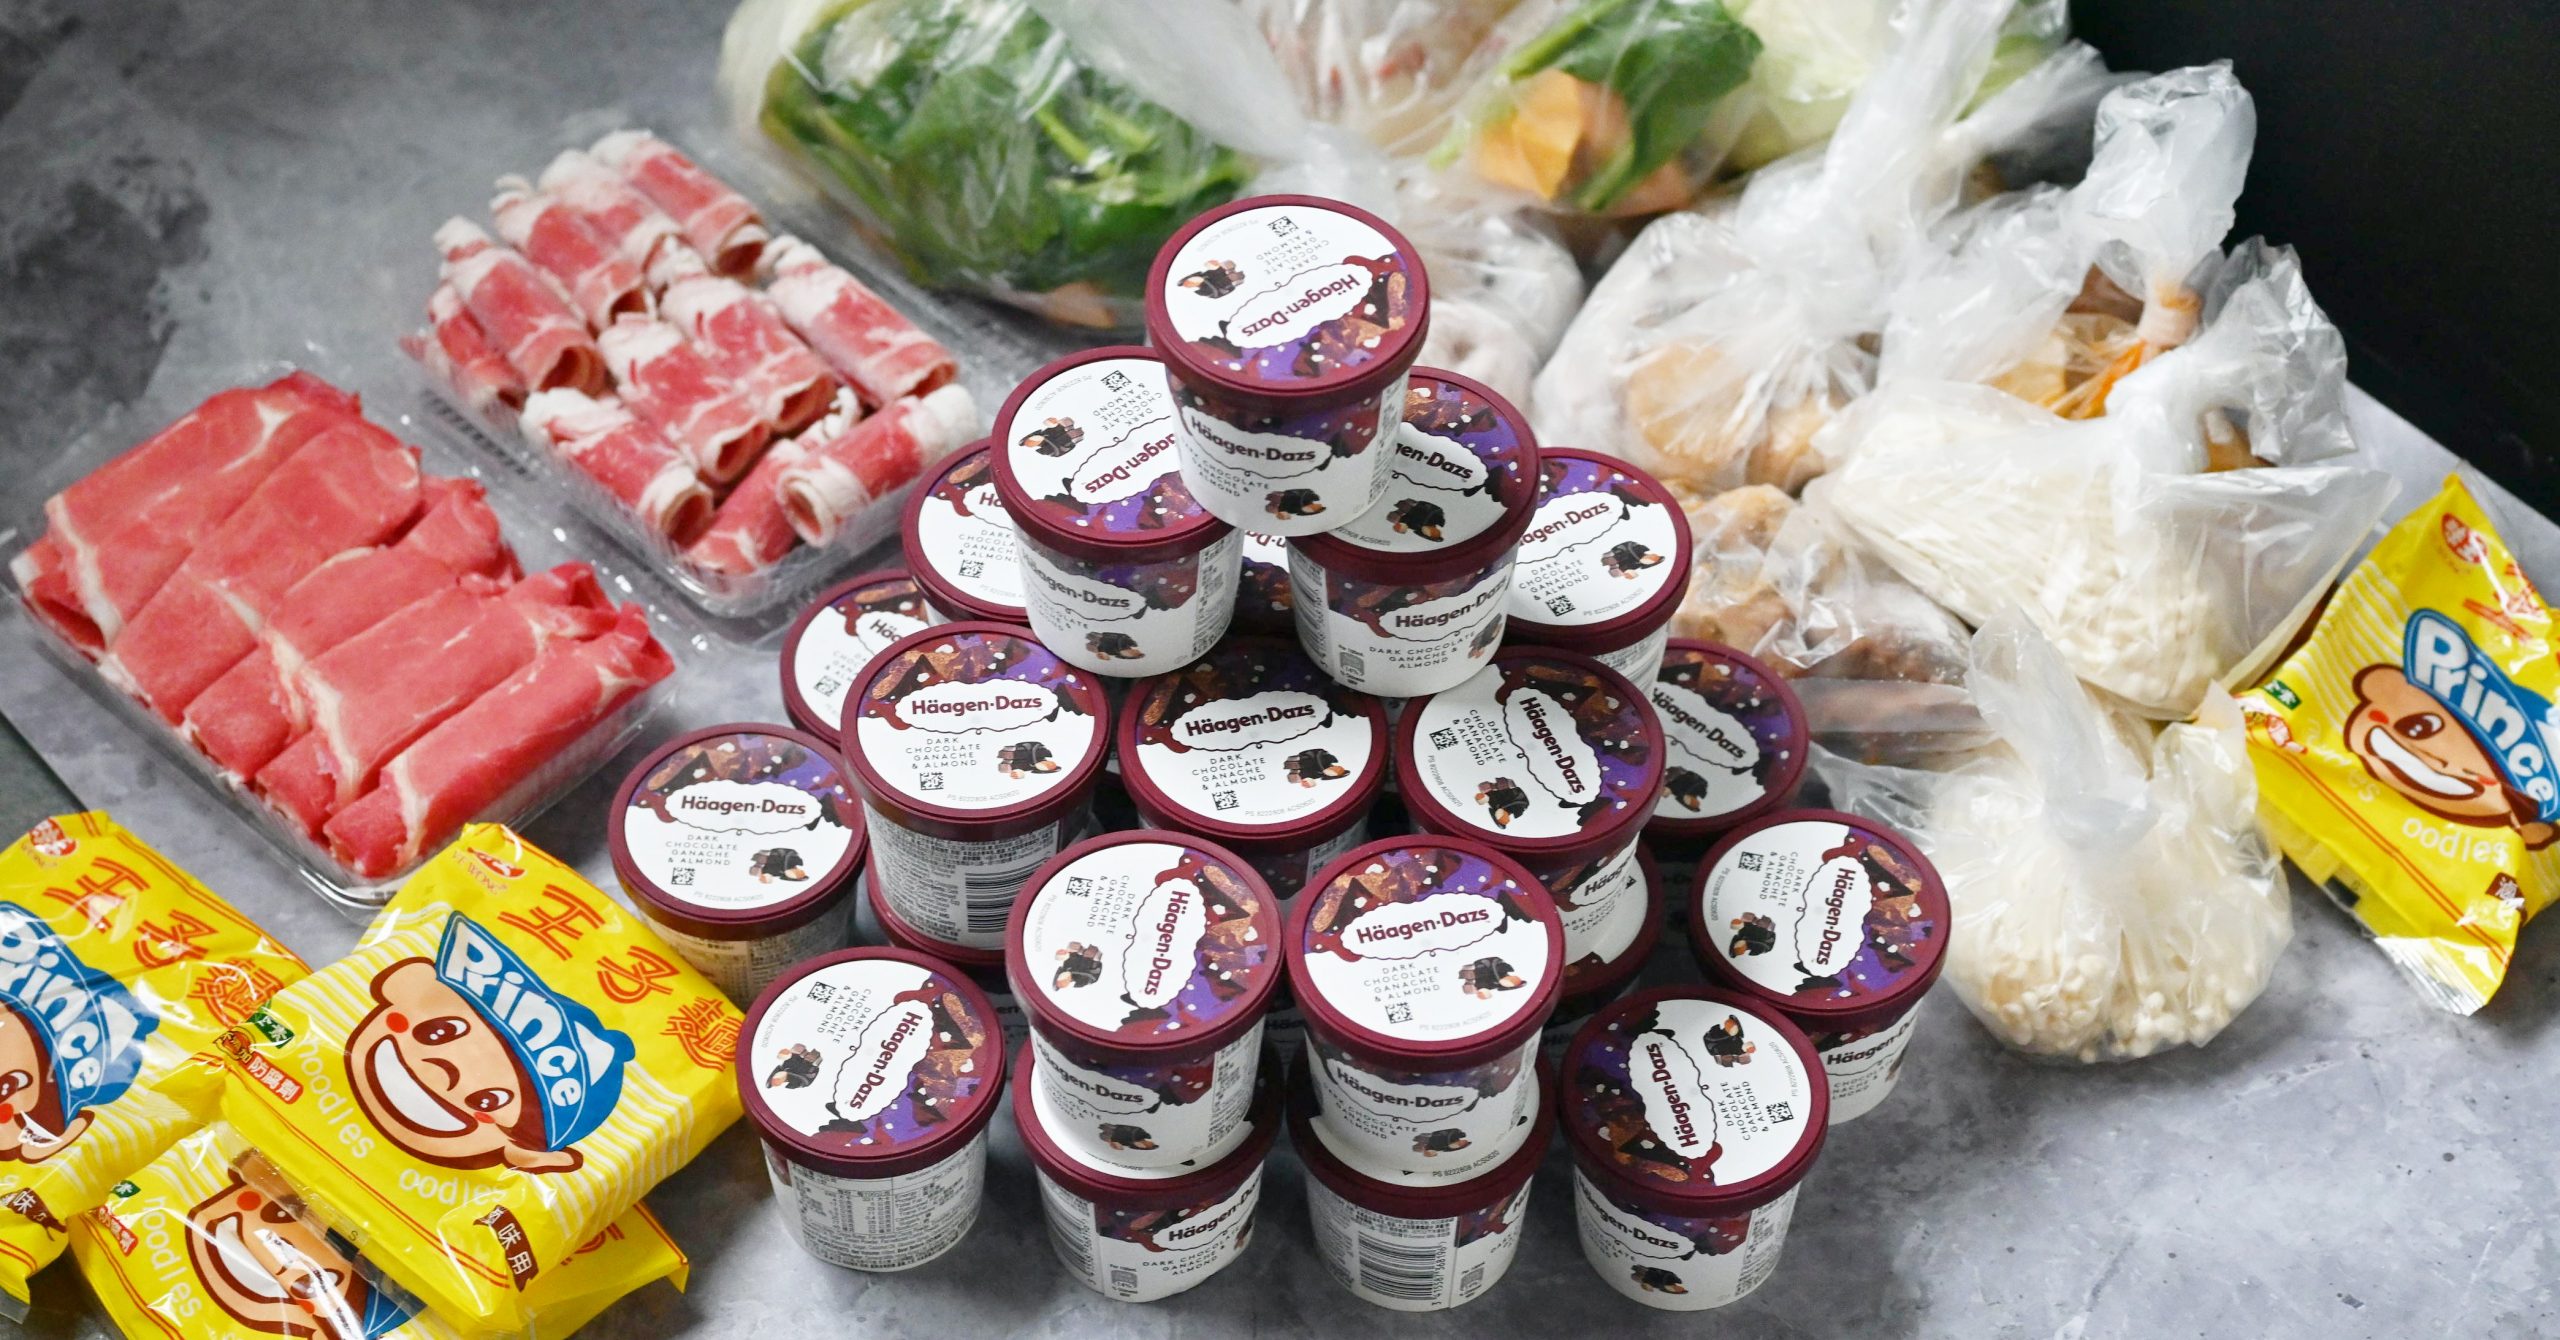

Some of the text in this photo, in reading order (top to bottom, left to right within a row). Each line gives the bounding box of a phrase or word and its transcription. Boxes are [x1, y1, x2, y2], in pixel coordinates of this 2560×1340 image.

[1256, 236, 1301, 260] ALMOND
[1264, 236, 1317, 264] GANACHE
[1264, 239, 1330, 276] CHOCOLATE
[1287, 254, 1318, 272] DARK
[1103, 392, 1162, 431] CHOCOLATE
[1124, 408, 1153, 425] DARK
[958, 534, 1015, 546] CHOCOLA
[1519, 559, 1584, 590] CHOCOLATE
[1530, 568, 1583, 593] GANACHE
[1531, 561, 1561, 576] DARK
[1545, 574, 1590, 597] ALMOND
[1369, 647, 1401, 655] DARK
[1399, 657, 1449, 669] ALMOND
[2416, 617, 2555, 806] Prince
[926, 737, 959, 745] DARK
[1456, 723, 1485, 766] ALMOND
[1463, 718, 1493, 761] GANACHE
[1469, 710, 1506, 764] CHOCOLATE
[1488, 721, 1506, 745] DARK
[906, 744, 980, 754] CHOCOLATE
[914, 752, 974, 761] GANACHE
[1210, 754, 1242, 765] DARK
[924, 760, 977, 768] ALMOND
[1192, 758, 1266, 776] CHOCOLATE
[1201, 766, 1261, 782] GANACHE
[1215, 773, 1266, 789] ALMOND
[666, 841, 738, 851] CHOCOLATE
[672, 850, 729, 858] GANACHE
[681, 858, 731, 866] ALMOND
[1759, 861, 1774, 900] ALMOND
[1770, 856, 1787, 900] GANACHE
[1778, 851, 1799, 907] CHOCOLATE
[1792, 870, 1805, 893] DARK
[1087, 886, 1104, 927] ALMOND
[1098, 879, 1117, 926] GANACHE
[1106, 876, 1130, 935] CHOCOLATE
[1121, 893, 1135, 919] DARK
[1364, 966, 1440, 987] CHOCOLATE
[1382, 963, 1415, 974] DARK
[1374, 976, 1436, 994] GANACHE
[1388, 985, 1441, 1000] ALMOND
[445, 920, 583, 1109] Prince
[816, 995, 845, 1033] ALMOND
[826, 991, 859, 1035] GANACHE
[833, 989, 871, 1044] CHOCOLATE
[851, 1007, 871, 1031] DARK
[1718, 1101, 1733, 1126] DARK
[1720, 1081, 1750, 1141] CHOCOLATE
[1733, 1084, 1758, 1132] GANACHE
[1742, 1081, 1765, 1128] ALMOND
